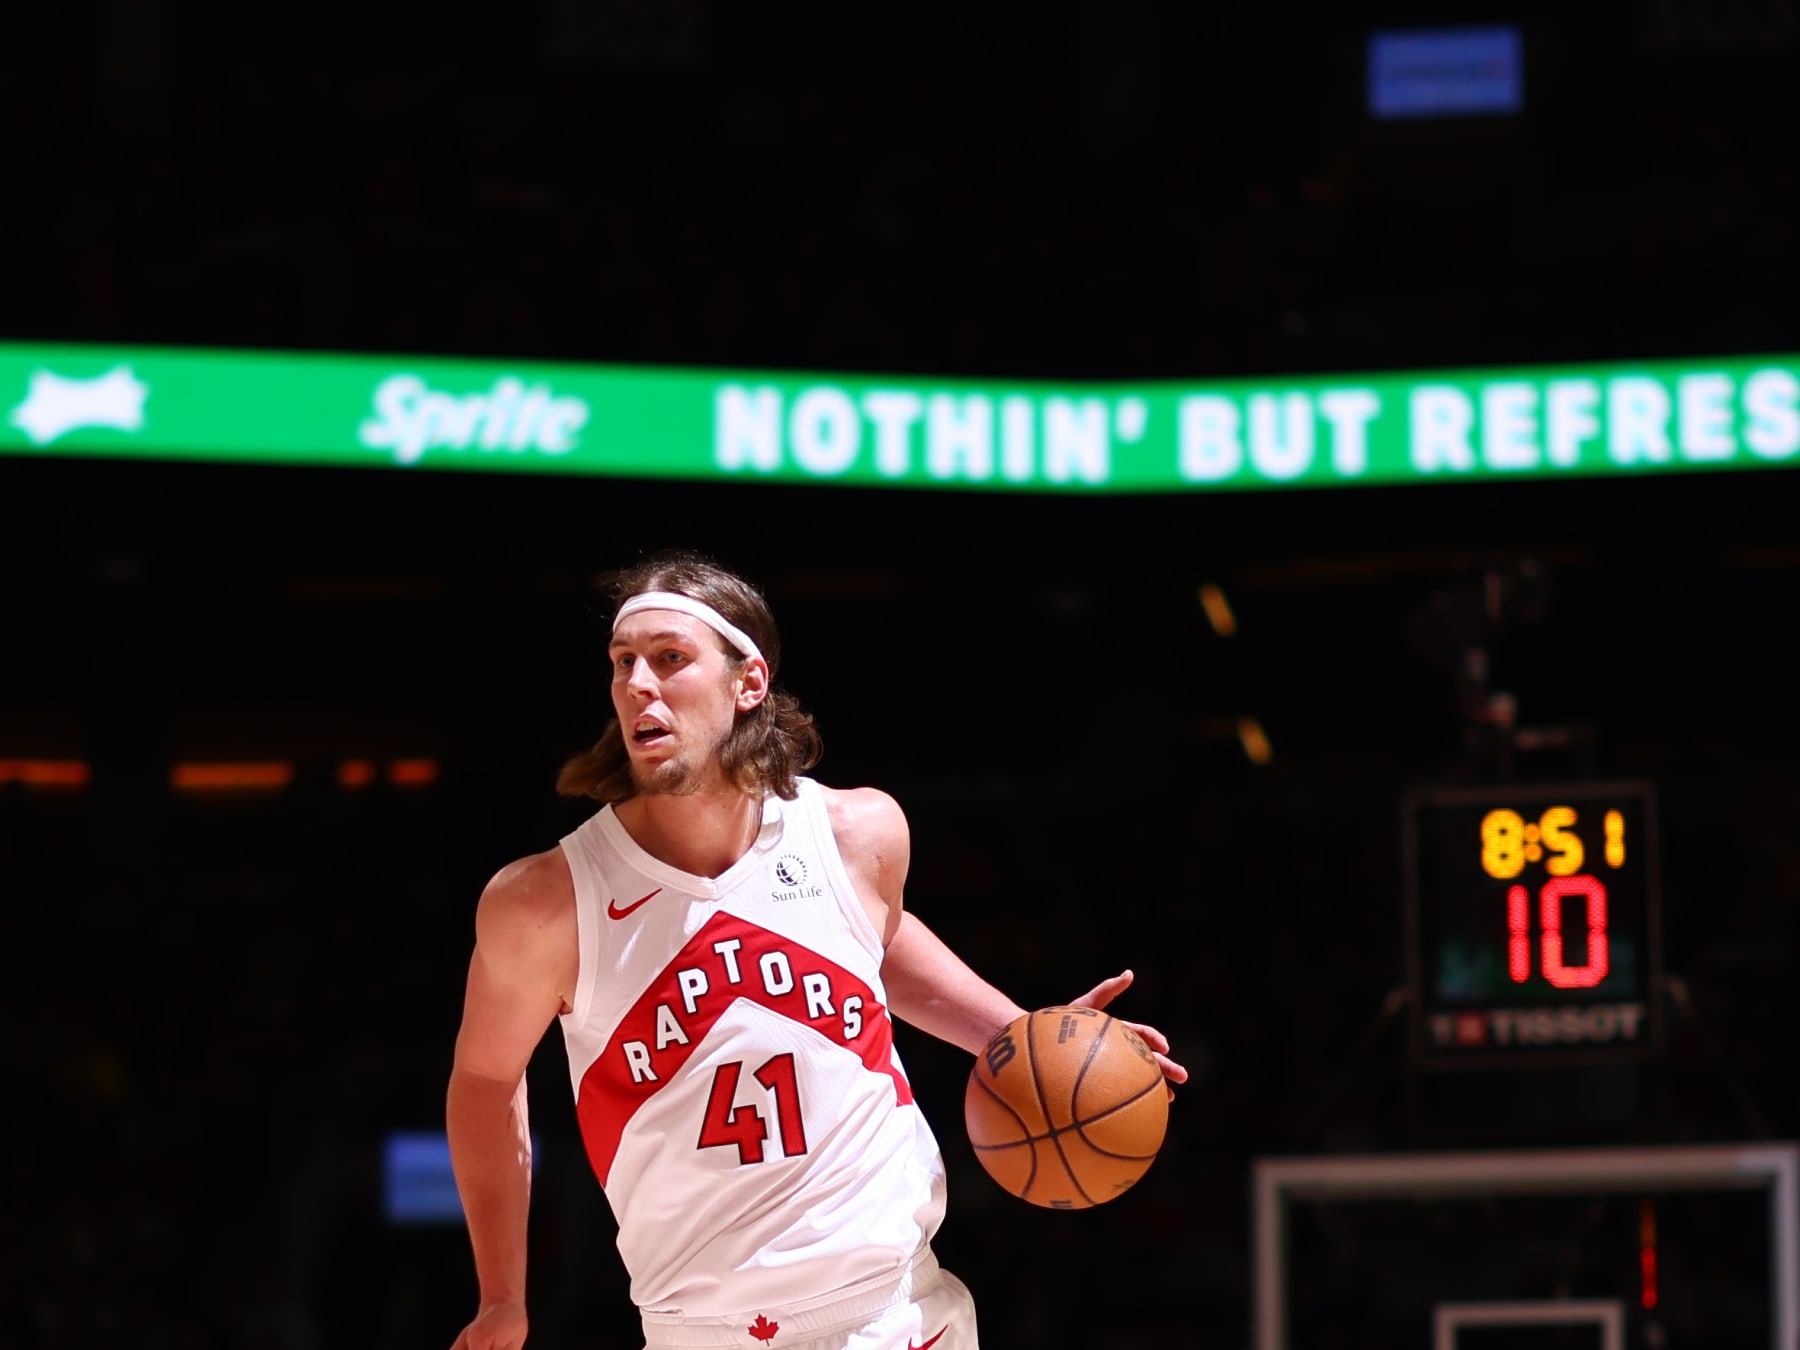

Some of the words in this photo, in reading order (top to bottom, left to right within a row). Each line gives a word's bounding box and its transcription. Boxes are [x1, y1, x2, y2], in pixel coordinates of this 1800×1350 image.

[359, 373, 589, 467] Sprite
[712, 383, 1147, 485] NOTHIN'
[1177, 386, 1382, 482] BUT
[1406, 366, 1800, 475] REFRES
[771, 890, 797, 903] Sun
[799, 885, 823, 899] Life
[1481, 806, 1626, 879] 8:51
[1507, 874, 1609, 988] 10
[622, 938, 863, 1083] RAPTORS
[1491, 1002, 1644, 1045] TISSOT
[696, 1052, 808, 1166] 41
